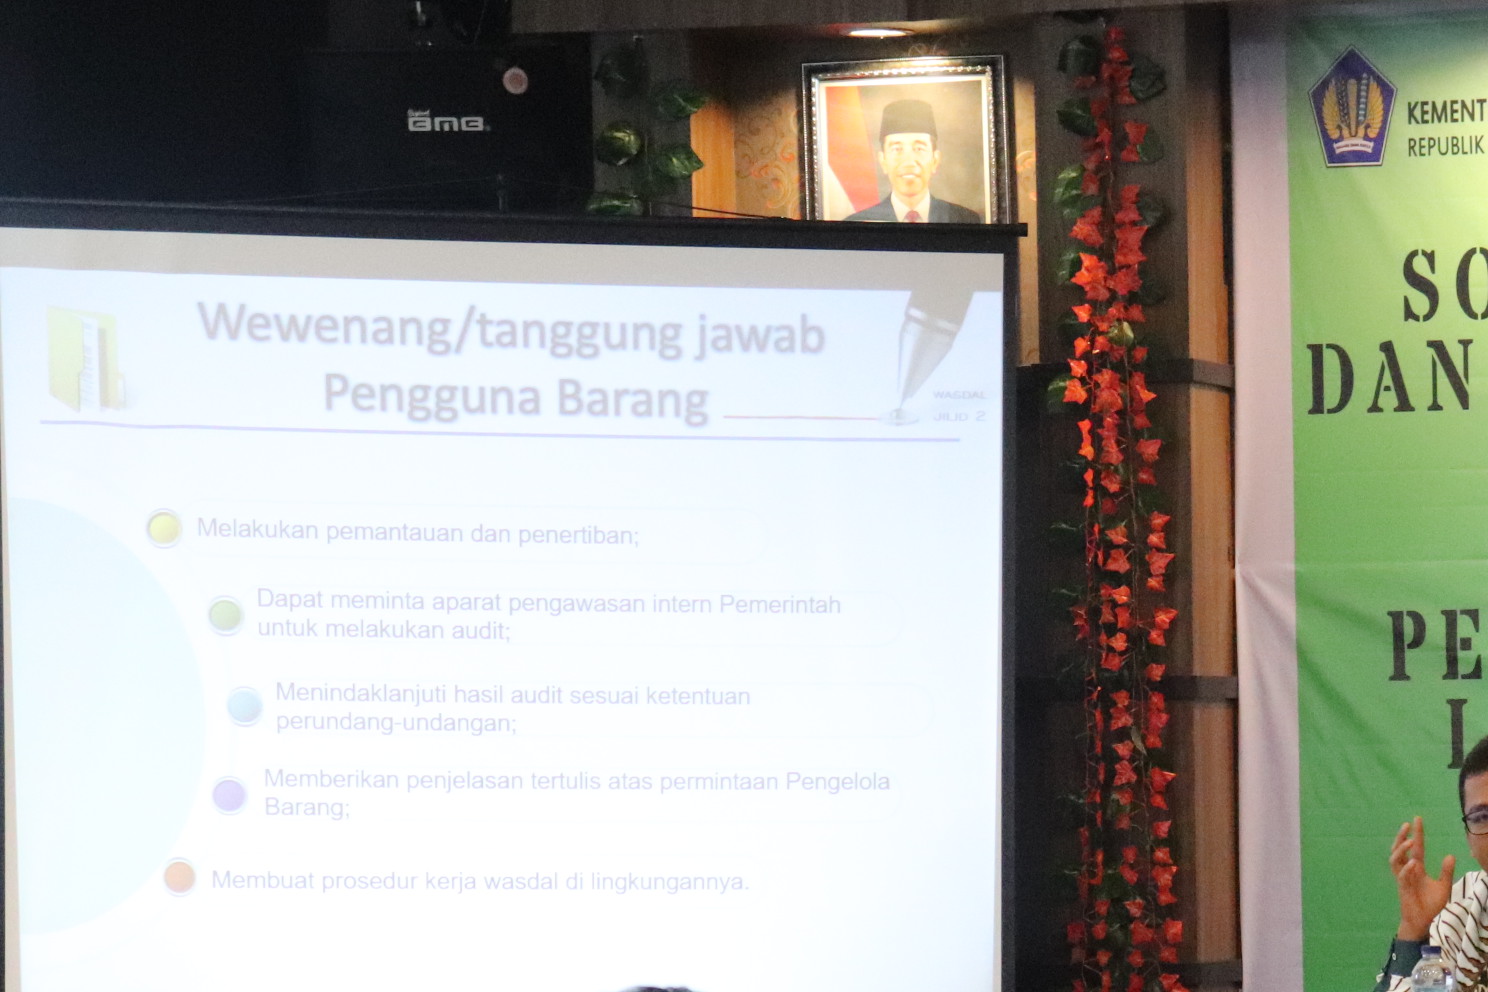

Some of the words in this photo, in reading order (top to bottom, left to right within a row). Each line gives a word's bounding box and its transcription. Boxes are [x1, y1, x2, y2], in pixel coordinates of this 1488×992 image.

[1408, 136, 1483, 157] REPUBLIK
[196, 302, 685, 360] Wewenang/tanggung
[692, 312, 828, 362] jawab
[1307, 340, 1472, 415] DAN
[323, 372, 542, 424] Pengguna
[556, 377, 711, 429] Barang
[975, 410, 986, 422] 2
[196, 516, 320, 540] Melakukan
[325, 523, 465, 545] pemantauan
[469, 523, 512, 543] dan
[517, 524, 640, 548] penertiban;
[256, 587, 333, 614] Dapat
[335, 590, 426, 612] meminta
[431, 593, 503, 615] aparat
[507, 596, 647, 617] pengawasan
[651, 593, 714, 614] intern
[718, 593, 843, 615] Pemerintah
[256, 617, 320, 637] untuk
[324, 618, 446, 639] melakukan
[450, 620, 512, 643] audit;
[274, 681, 448, 708] Menindaklanjuti
[453, 684, 505, 704] hasil
[509, 685, 564, 705] audit
[568, 685, 640, 705] sesuai
[645, 685, 752, 706] ketentuan
[275, 711, 518, 737] perundang-undangan;
[263, 767, 401, 789] Memberikan
[405, 770, 525, 794] penjelasan
[529, 771, 603, 790] tertulis
[606, 772, 654, 791] atas
[659, 771, 780, 795] permintaan
[785, 771, 892, 796] Pengelola
[263, 796, 351, 822] Barang;
[210, 869, 316, 890] Membuat
[320, 871, 420, 894] prosedur
[424, 871, 478, 895] kerja
[482, 871, 560, 891] wasdal
[564, 871, 585, 891] di
[590, 871, 751, 896] lingkungannya.
